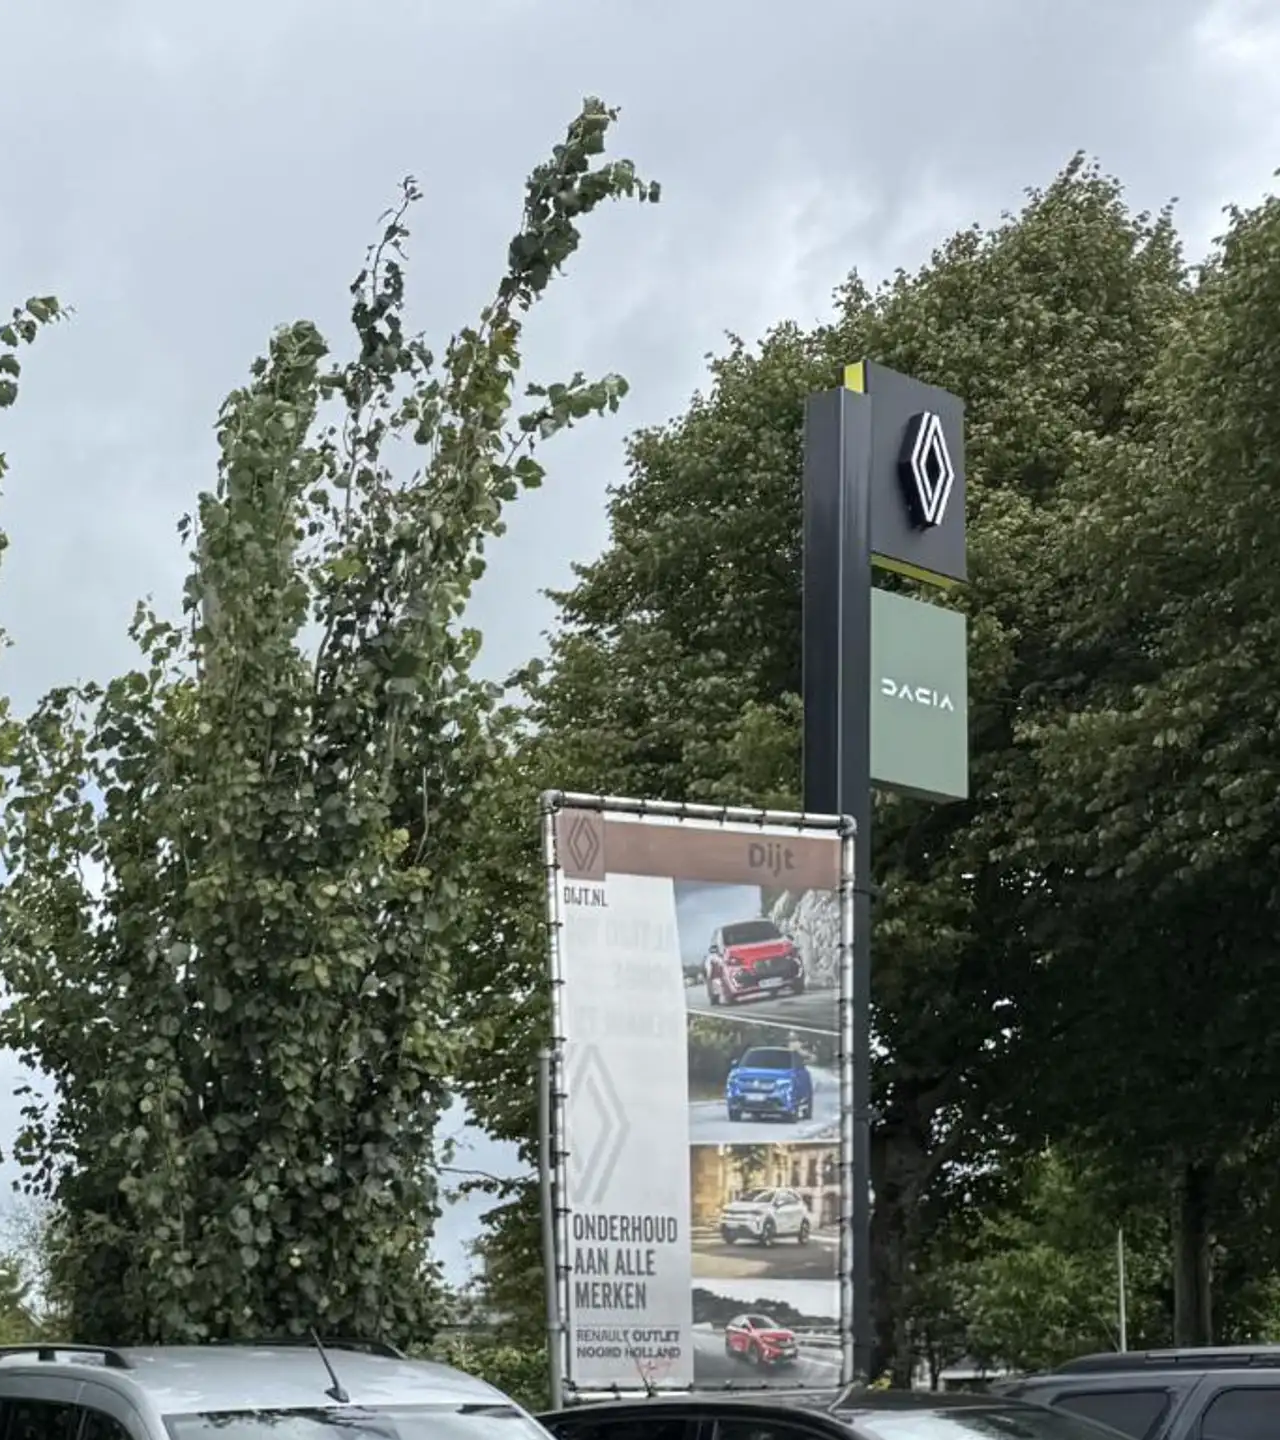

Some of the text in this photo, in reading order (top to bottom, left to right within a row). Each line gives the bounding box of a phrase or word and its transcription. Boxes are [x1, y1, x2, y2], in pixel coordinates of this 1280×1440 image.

[881, 677, 954, 712] DACIA
[749, 843, 796, 878] Dijt
[573, 1213, 678, 1243] ONDERHOUD
[574, 1247, 657, 1276] AAN ALLE
[575, 1281, 646, 1310] MERKEN
[576, 1329, 680, 1343] RENAULT OUTLET
[576, 1345, 682, 1359] NOORD HOLLAND
